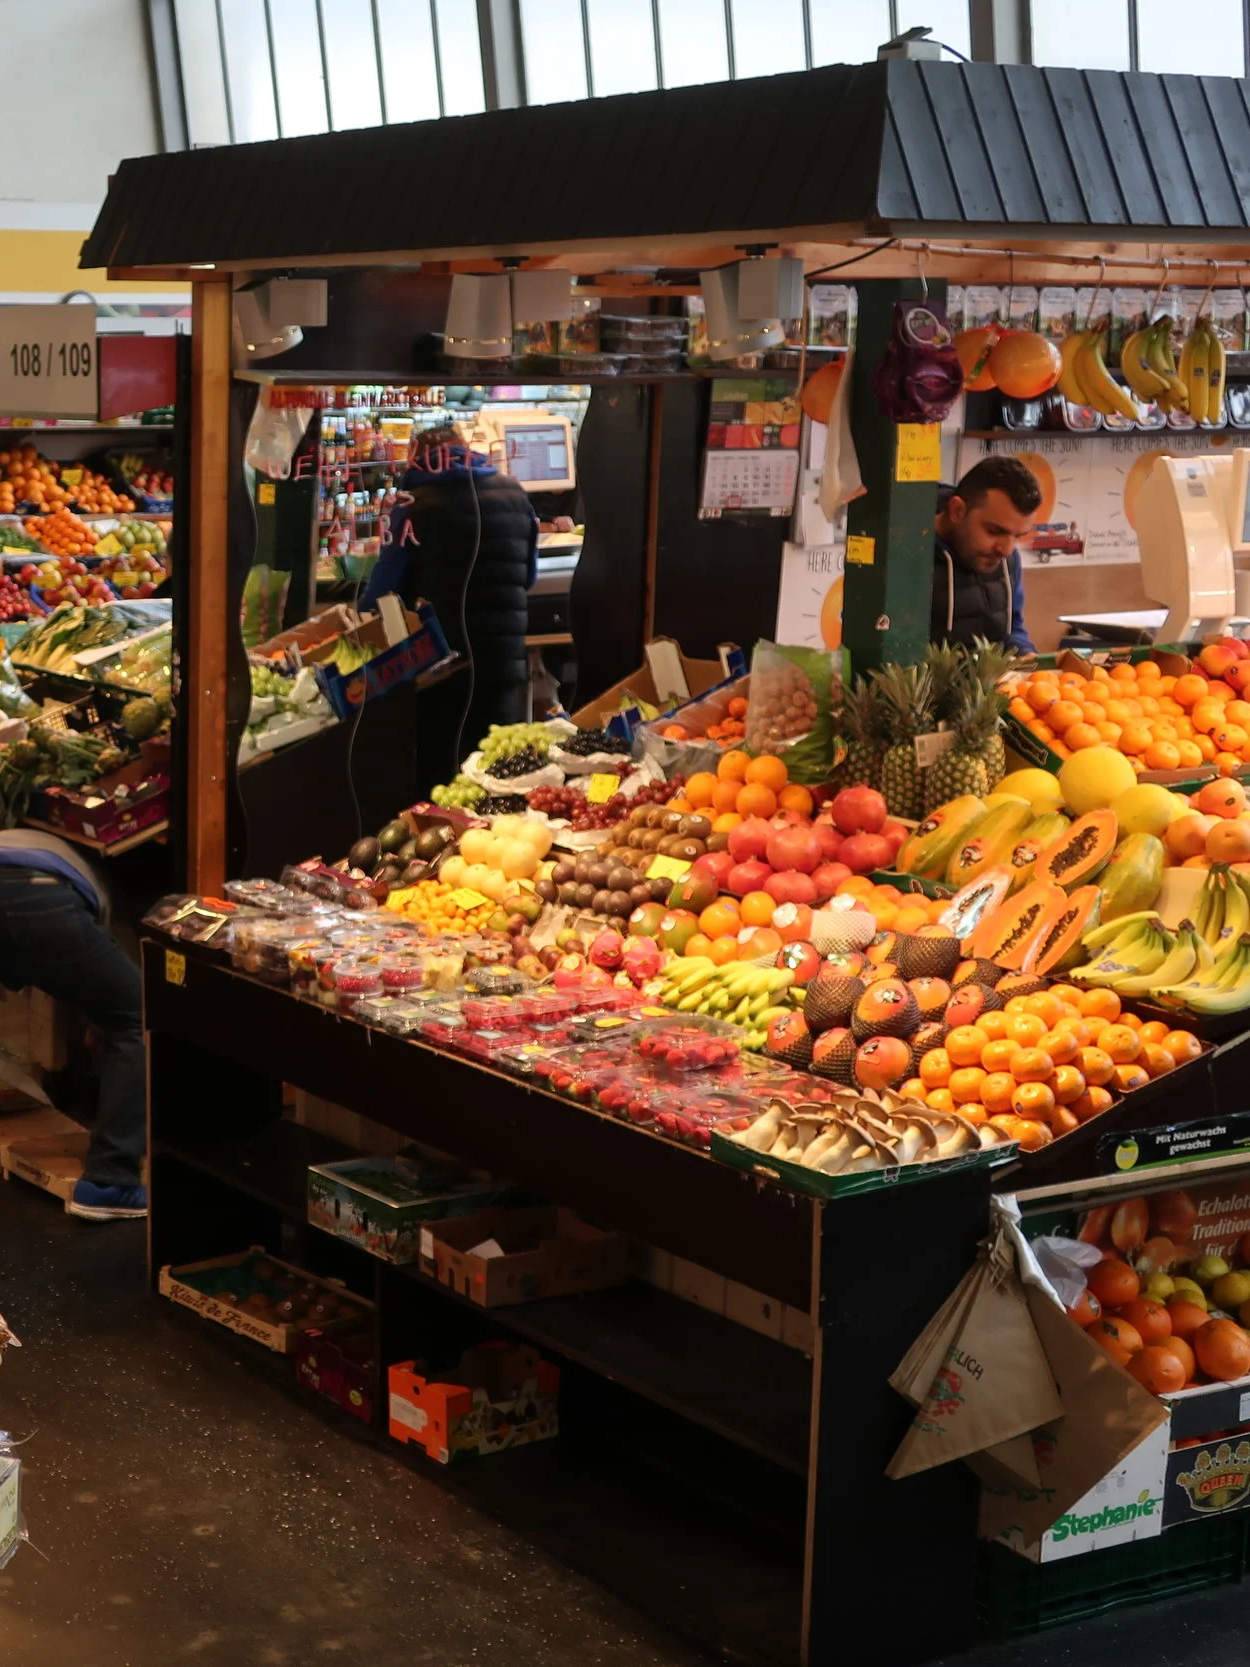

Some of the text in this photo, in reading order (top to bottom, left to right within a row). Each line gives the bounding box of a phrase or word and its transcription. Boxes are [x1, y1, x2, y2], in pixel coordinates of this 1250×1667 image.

[11, 344, 41, 376] 108
[47, 343, 53, 376] /
[59, 342, 90, 376] 109
[807, 552, 832, 573] HERE
[1155, 1133, 1173, 1145] Mit
[1173, 1126, 1227, 1142] Naturwachs
[1169, 1139, 1212, 1156] gewachst
[1192, 1218, 1250, 1241] Tradition
[207, 1304, 222, 1318] de
[222, 1310, 271, 1341] France
[1200, 1472, 1244, 1494] QUEEN
[1052, 1498, 1157, 1543] Stephanie
